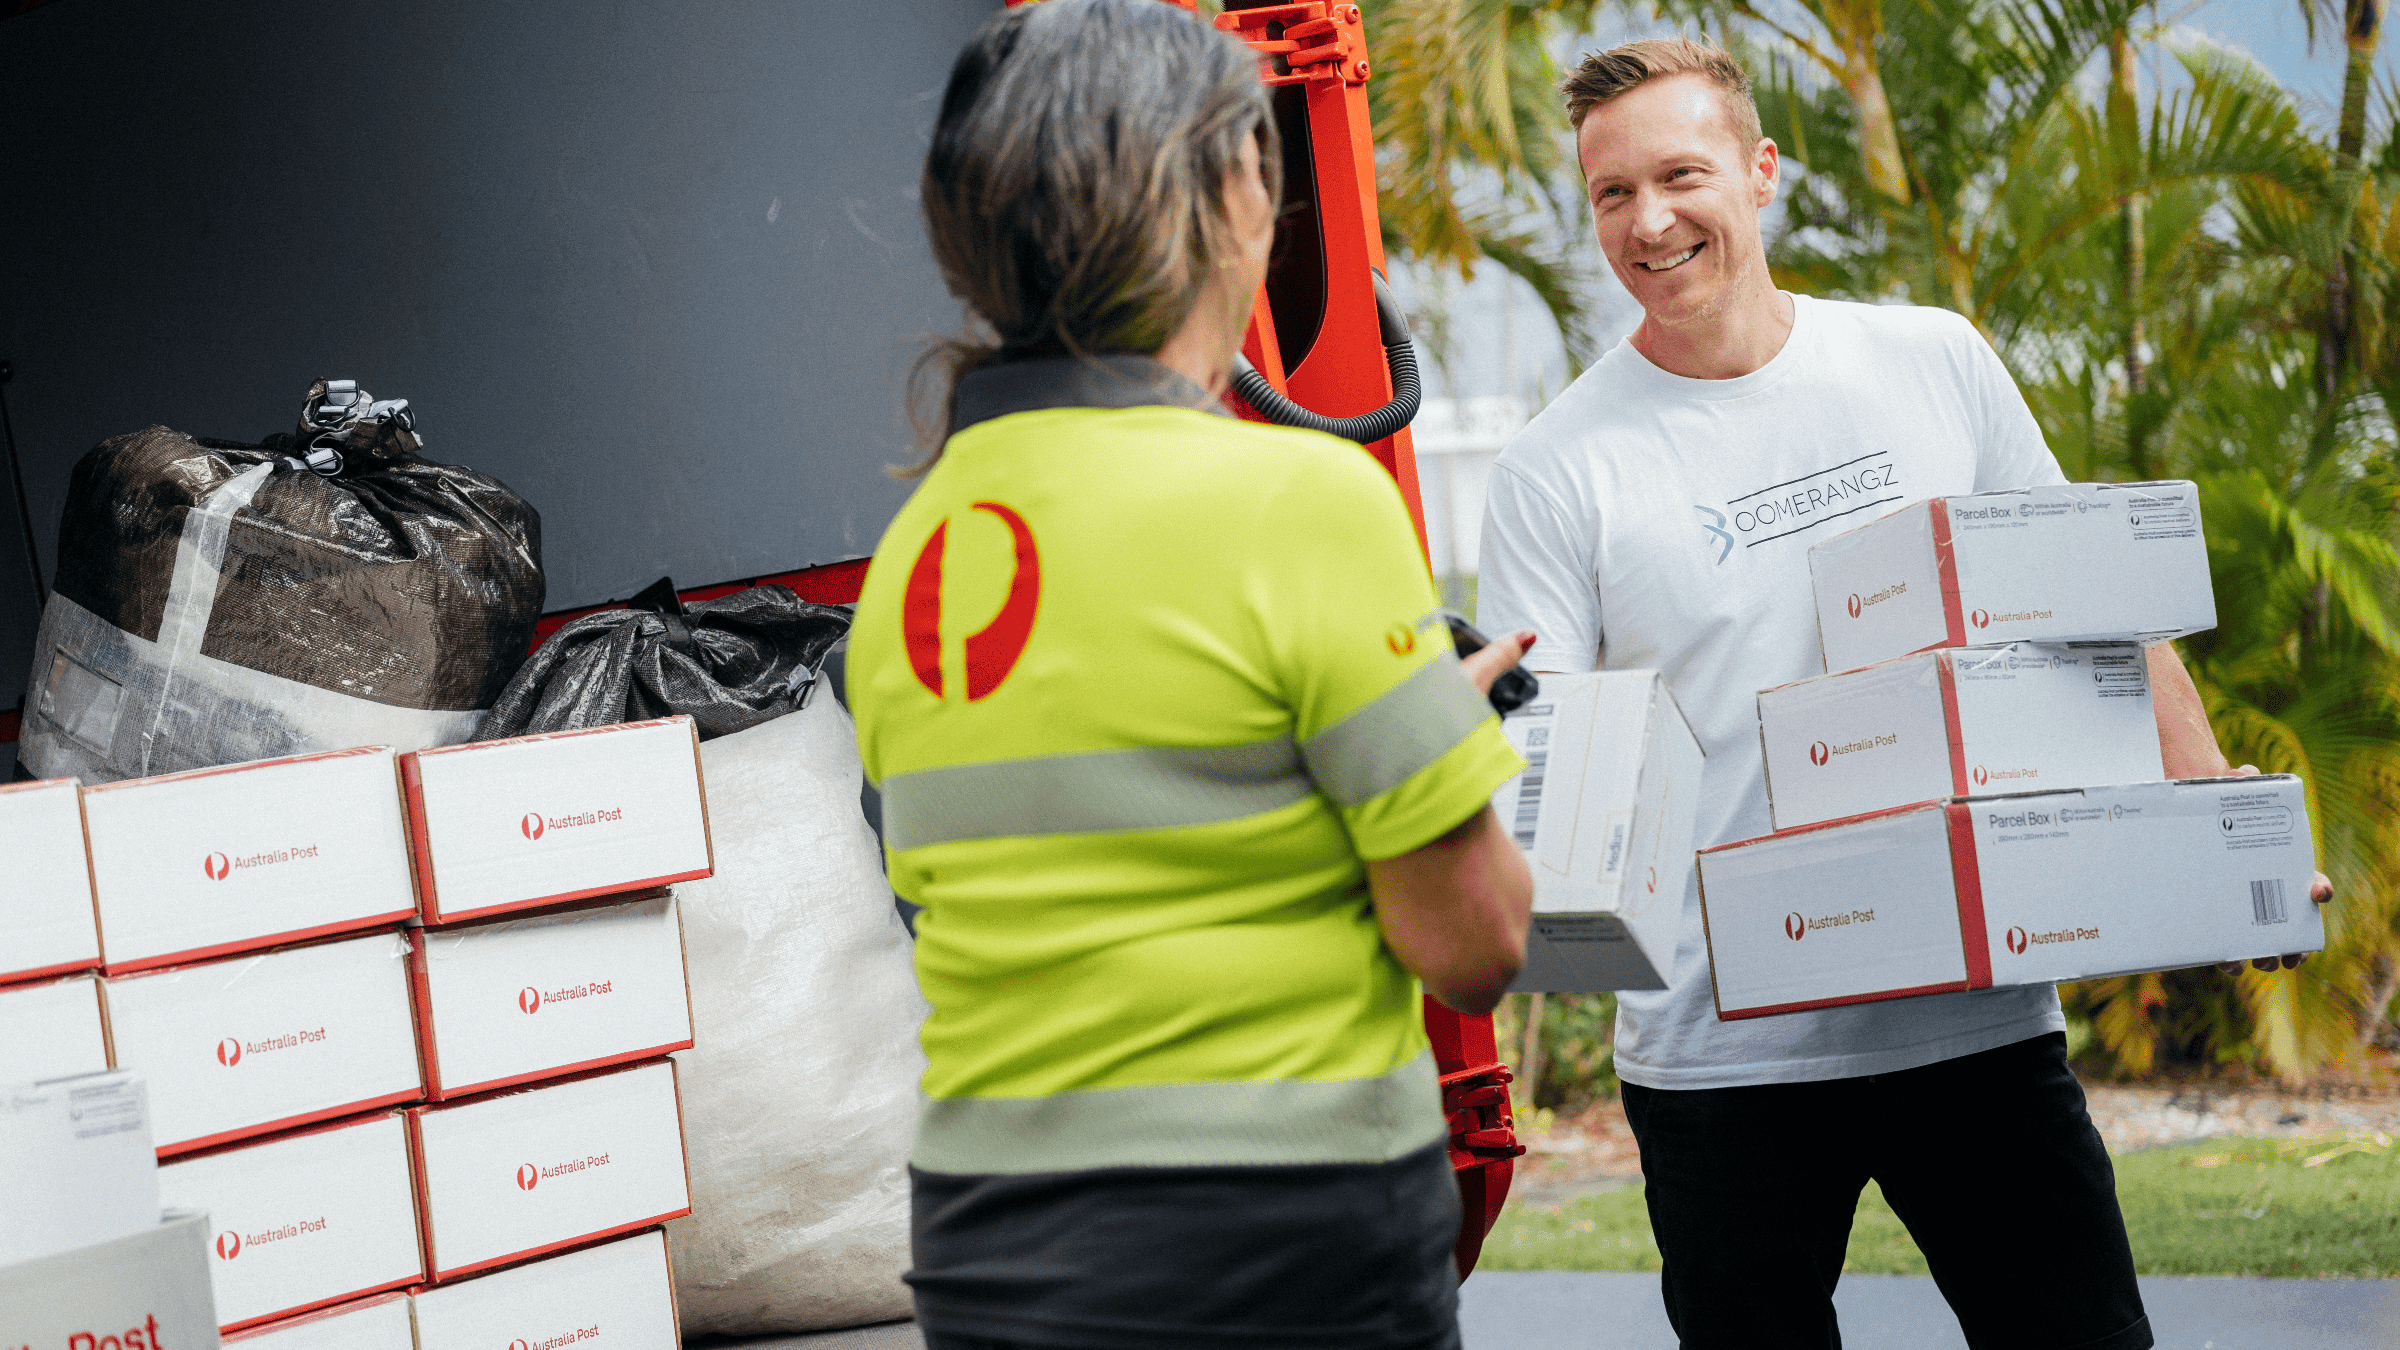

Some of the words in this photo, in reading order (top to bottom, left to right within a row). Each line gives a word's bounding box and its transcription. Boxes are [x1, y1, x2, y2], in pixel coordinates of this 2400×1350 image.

[1955, 507, 1989, 520] Parcel
[1991, 506, 2011, 518] Box
[1862, 587, 1890, 608] Australia
[1891, 580, 1907, 596] Post
[1992, 610, 2031, 622] Australia
[2033, 609, 2053, 620] Post
[1832, 737, 1873, 756] Australia
[1875, 732, 1897, 747] Post
[1989, 769, 2021, 780] Australia
[2022, 768, 2038, 778] Post
[547, 811, 595, 831] Australia
[598, 807, 622, 822] Post
[1989, 812, 2027, 829] Parcel
[2028, 811, 2050, 826] Box
[235, 849, 289, 870] Australia
[291, 844, 318, 860] Post
[1808, 911, 1850, 931] Australia
[1852, 907, 1875, 923] Post
[2030, 929, 2075, 945] Australia
[2076, 926, 2100, 940] Post
[543, 984, 587, 1004] Australia
[589, 979, 613, 996] Post
[246, 1031, 297, 1055] Australia
[300, 1026, 326, 1044] Post
[541, 1159, 586, 1180] Australia
[587, 1152, 610, 1168] Post
[245, 1223, 297, 1248] Australia
[299, 1216, 326, 1235] Post
[532, 1331, 576, 1350] Australia
[577, 1324, 600, 1341] Post
